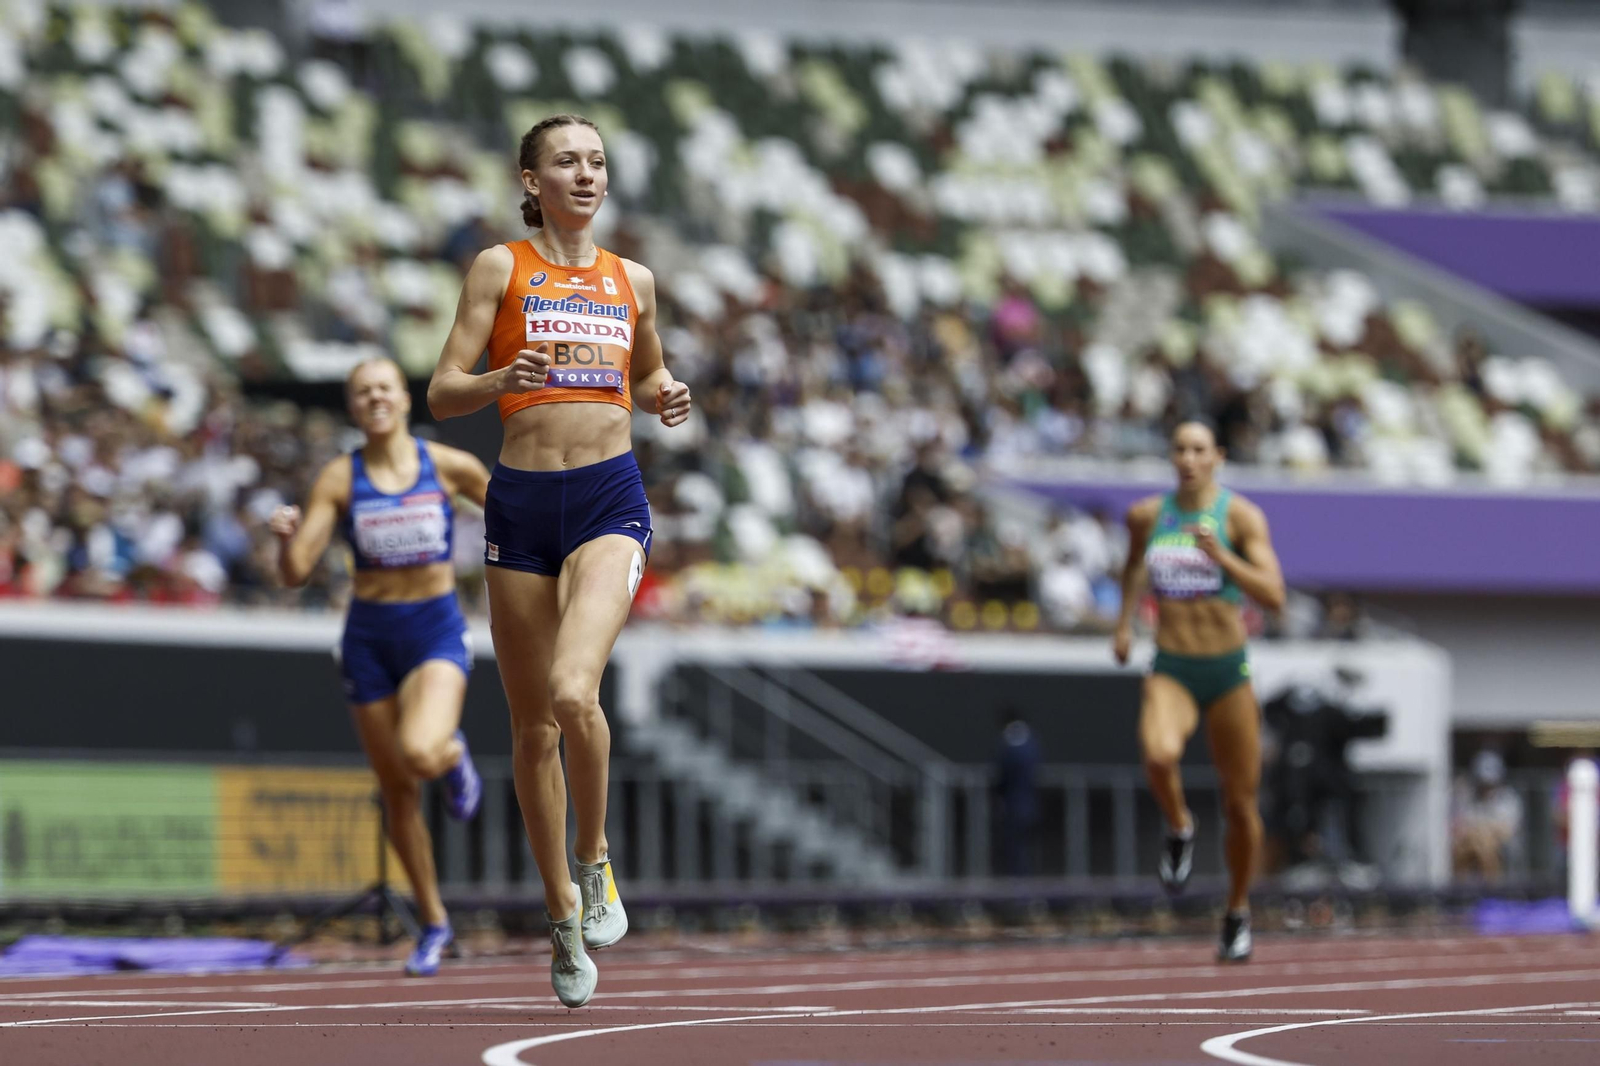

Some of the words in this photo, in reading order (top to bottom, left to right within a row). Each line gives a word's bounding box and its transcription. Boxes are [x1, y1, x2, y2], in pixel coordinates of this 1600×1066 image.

[554, 282, 597, 292] Staatsloterij
[522, 294, 629, 320] Nederland
[529, 320, 629, 342] HONDA
[554, 343, 614, 366] BOL
[556, 373, 616, 383] TOKYO
